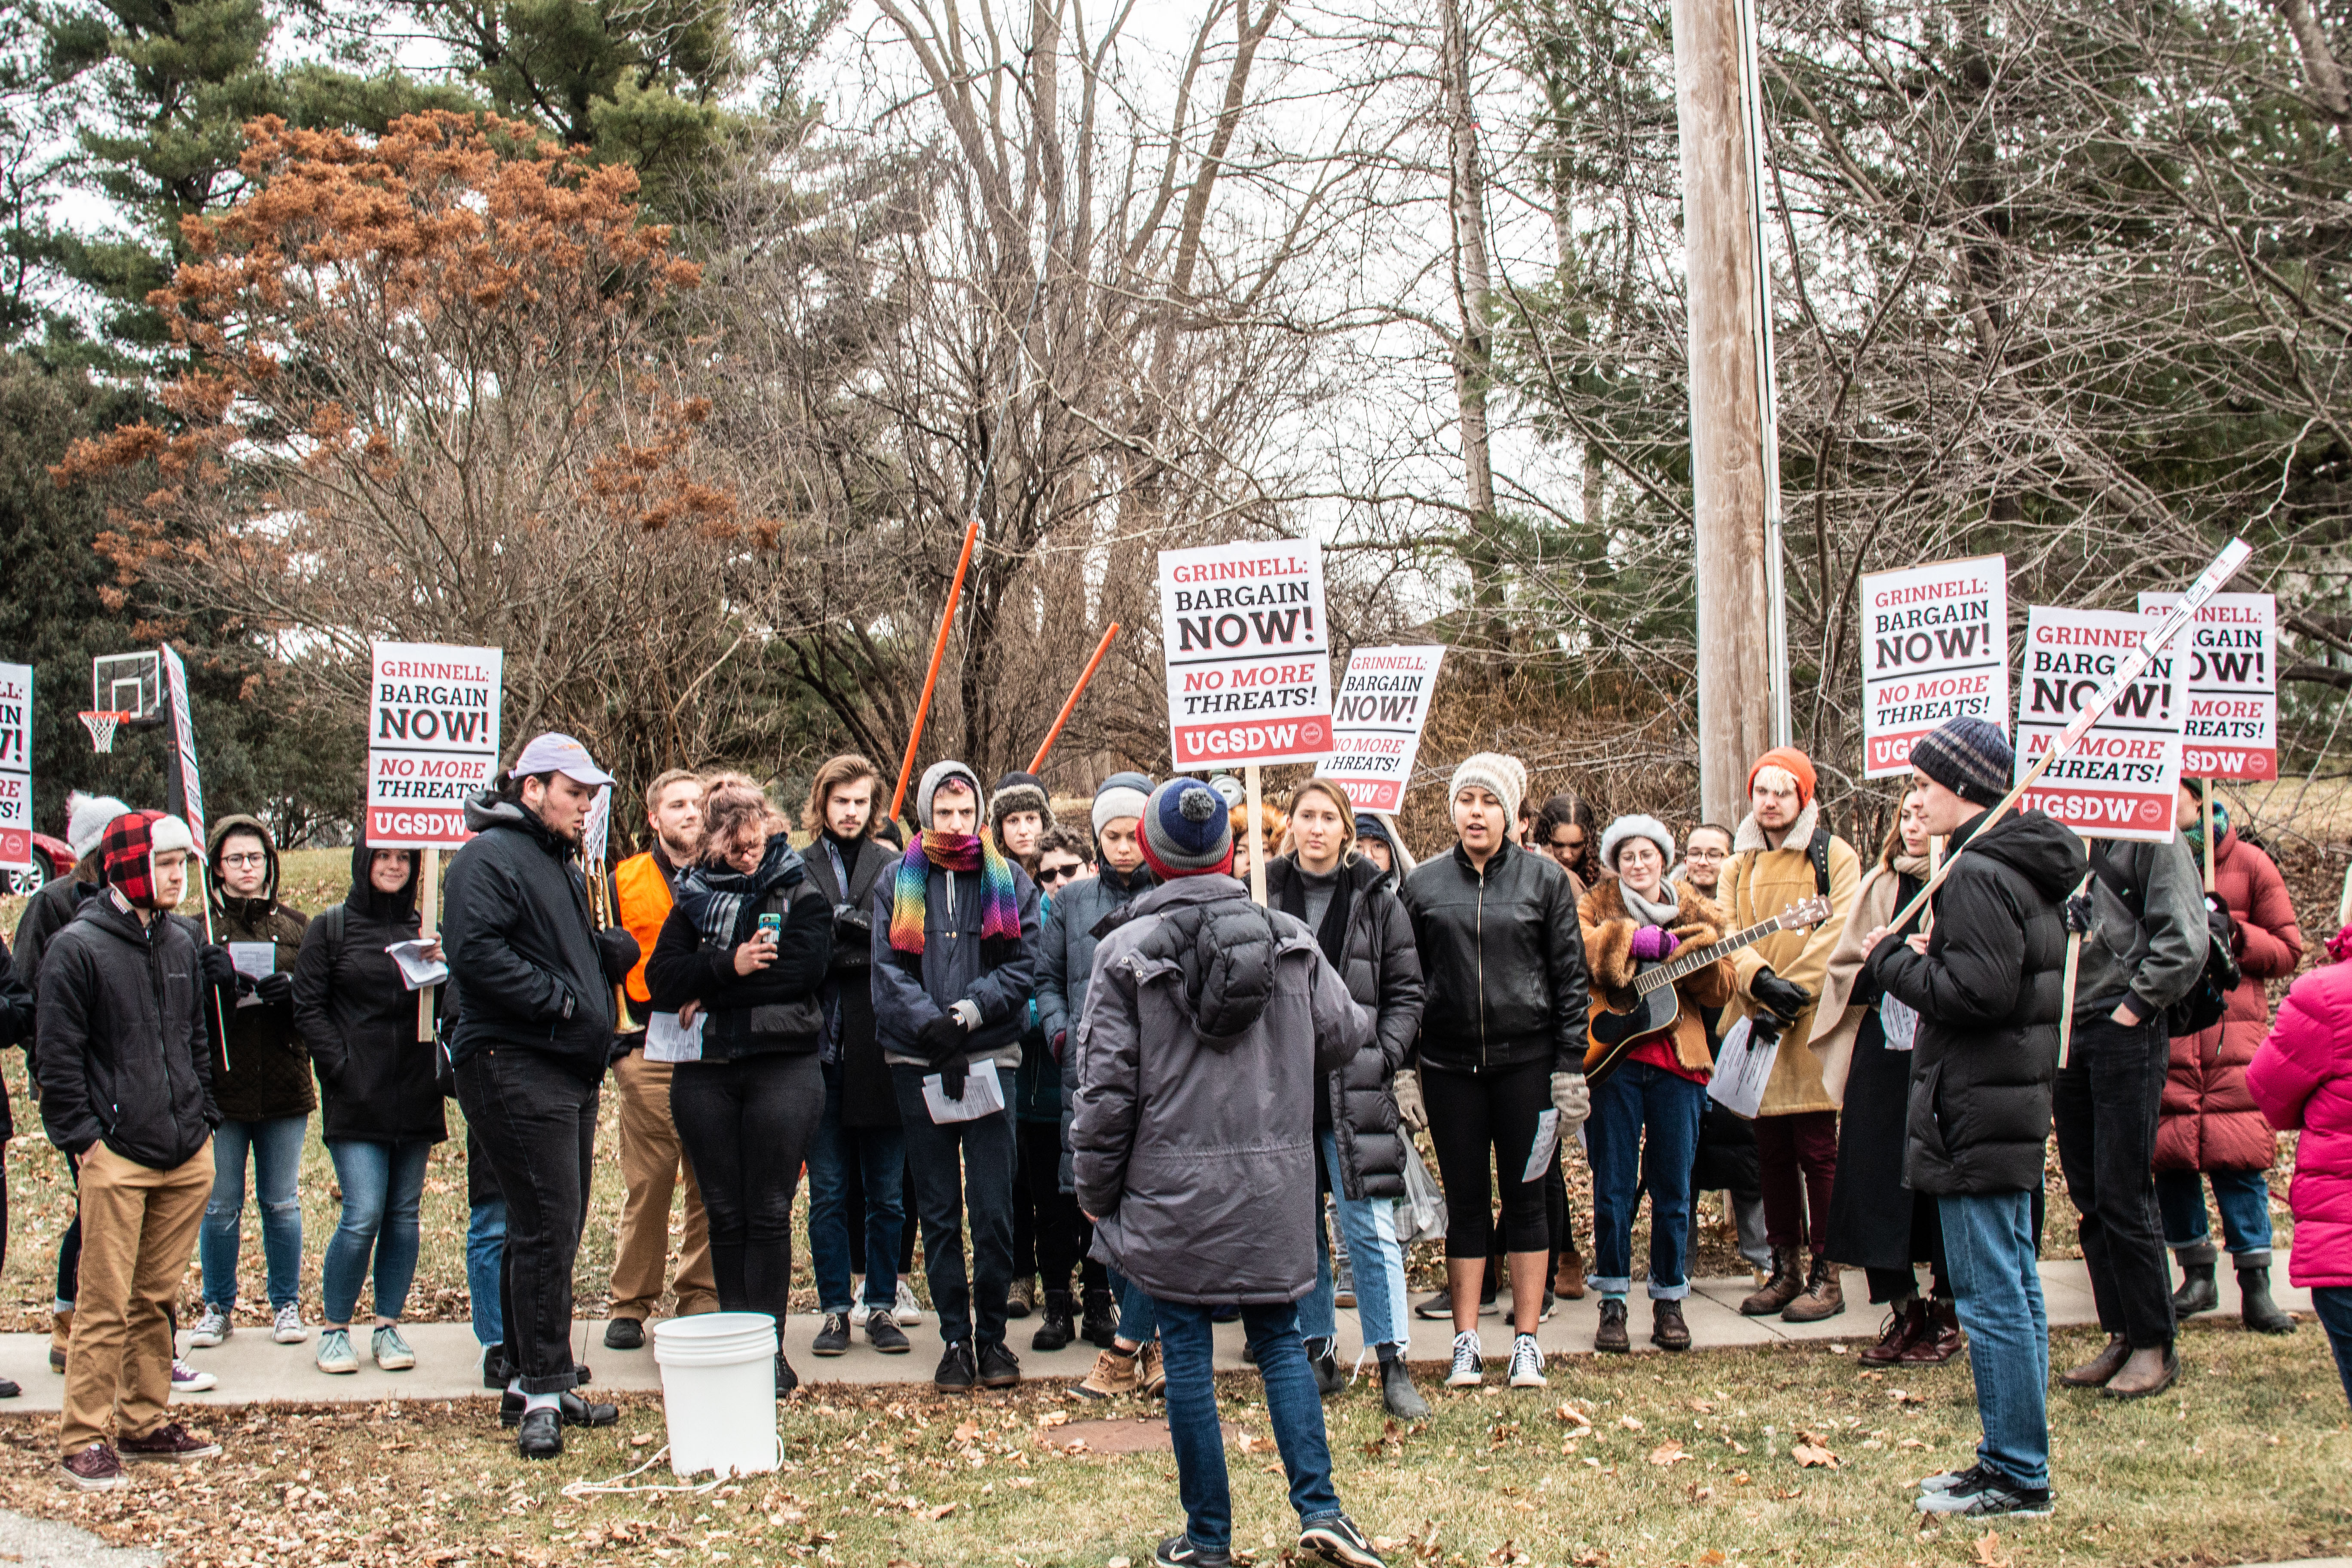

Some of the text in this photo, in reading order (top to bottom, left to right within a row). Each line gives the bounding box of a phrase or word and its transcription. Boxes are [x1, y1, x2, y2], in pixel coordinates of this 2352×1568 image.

[1173, 557, 1308, 583] GRINNELL:
[1175, 581, 1309, 612] BARGAIN
[1875, 578, 1988, 608] GRINNELL:
[1177, 606, 1314, 652] NOW!
[1875, 600, 1988, 633] BARGAIN
[1876, 622, 1990, 669] NOW!
[2193, 629, 2262, 647] GAIN
[381, 661, 489, 683] GRINNELL:
[1183, 663, 1316, 692] NO MORE
[1351, 656, 1428, 671] GRINNELL:
[2189, 651, 2264, 683] OW!
[380, 684, 489, 707] BARGAIN
[1345, 675, 1423, 692] BARGAIN
[1877, 675, 1989, 706] NO MORE
[1184, 686, 1317, 715] THREATS!
[1337, 695, 1418, 724] NOW!
[1877, 696, 1990, 726] THREATS!
[2190, 700, 2264, 718] MORE
[379, 707, 489, 744] NOW!
[1185, 723, 1298, 756] UGSDW
[2184, 720, 2265, 739] REATS!
[1353, 738, 1405, 753] MORE
[2027, 734, 2165, 760] N MORE
[378, 759, 486, 779] NO MORE
[2180, 750, 2246, 773] SDW
[2021, 793, 2138, 823] UGSDW
[375, 812, 466, 836] UGSDW
